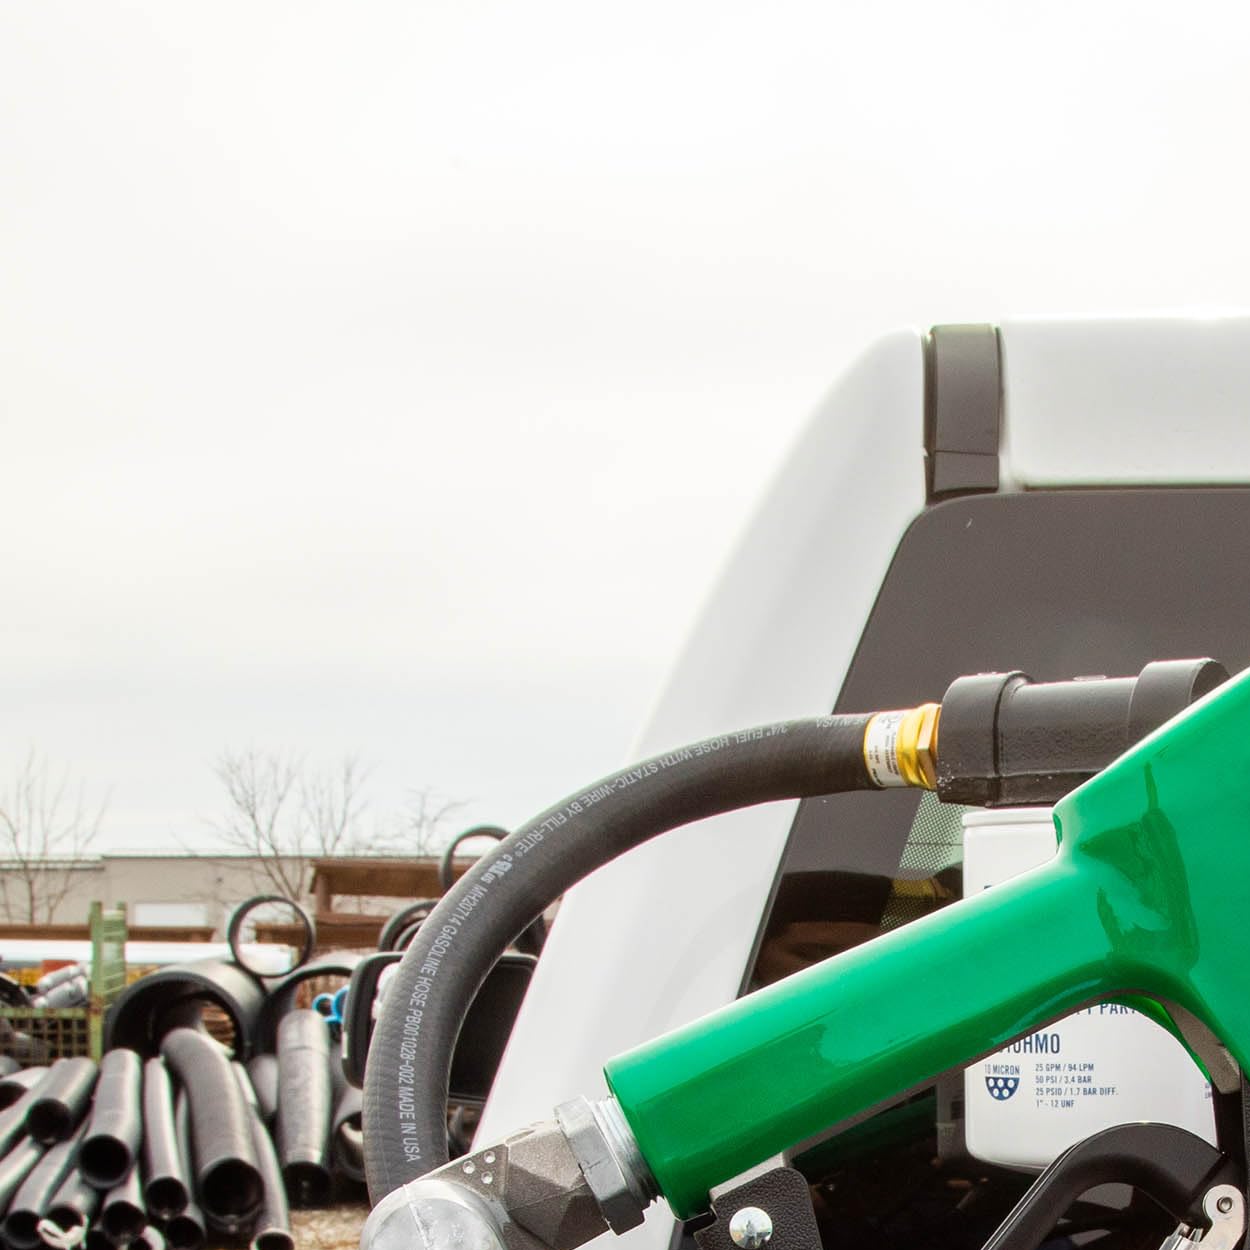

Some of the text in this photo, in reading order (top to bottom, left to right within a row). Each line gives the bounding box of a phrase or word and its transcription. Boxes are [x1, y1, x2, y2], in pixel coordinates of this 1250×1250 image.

[693, 735, 729, 756] HOSE
[735, 727, 763, 744] FUEL
[659, 749, 693, 769] WITH
[585, 761, 658, 808] STATIC-WIRE
[568, 801, 584, 818] BY
[448, 884, 489, 926] MH20714
[420, 924, 457, 977] GASOLINE
[409, 975, 433, 1008] HOSE
[1100, 1003, 1135, 1015] PAR
[398, 1006, 424, 1085] PB001028-002
[992, 1063, 1020, 1075] MICRON
[1035, 1063, 1044, 1072] 25
[1045, 1063, 1061, 1072] GPM
[1079, 1063, 1094, 1072] LPM
[1045, 1075, 1057, 1084] PSI
[1064, 1075, 1075, 1084] 3.4
[1077, 1075, 1092, 1084] BAR
[1035, 1087, 1044, 1096] 25
[1083, 1087, 1097, 1096] BAR
[1099, 1087, 1119, 1096] DIFF.
[398, 1086, 416, 1120] MADE
[400, 1122, 417, 1137] IN
[403, 1137, 421, 1163] USA
